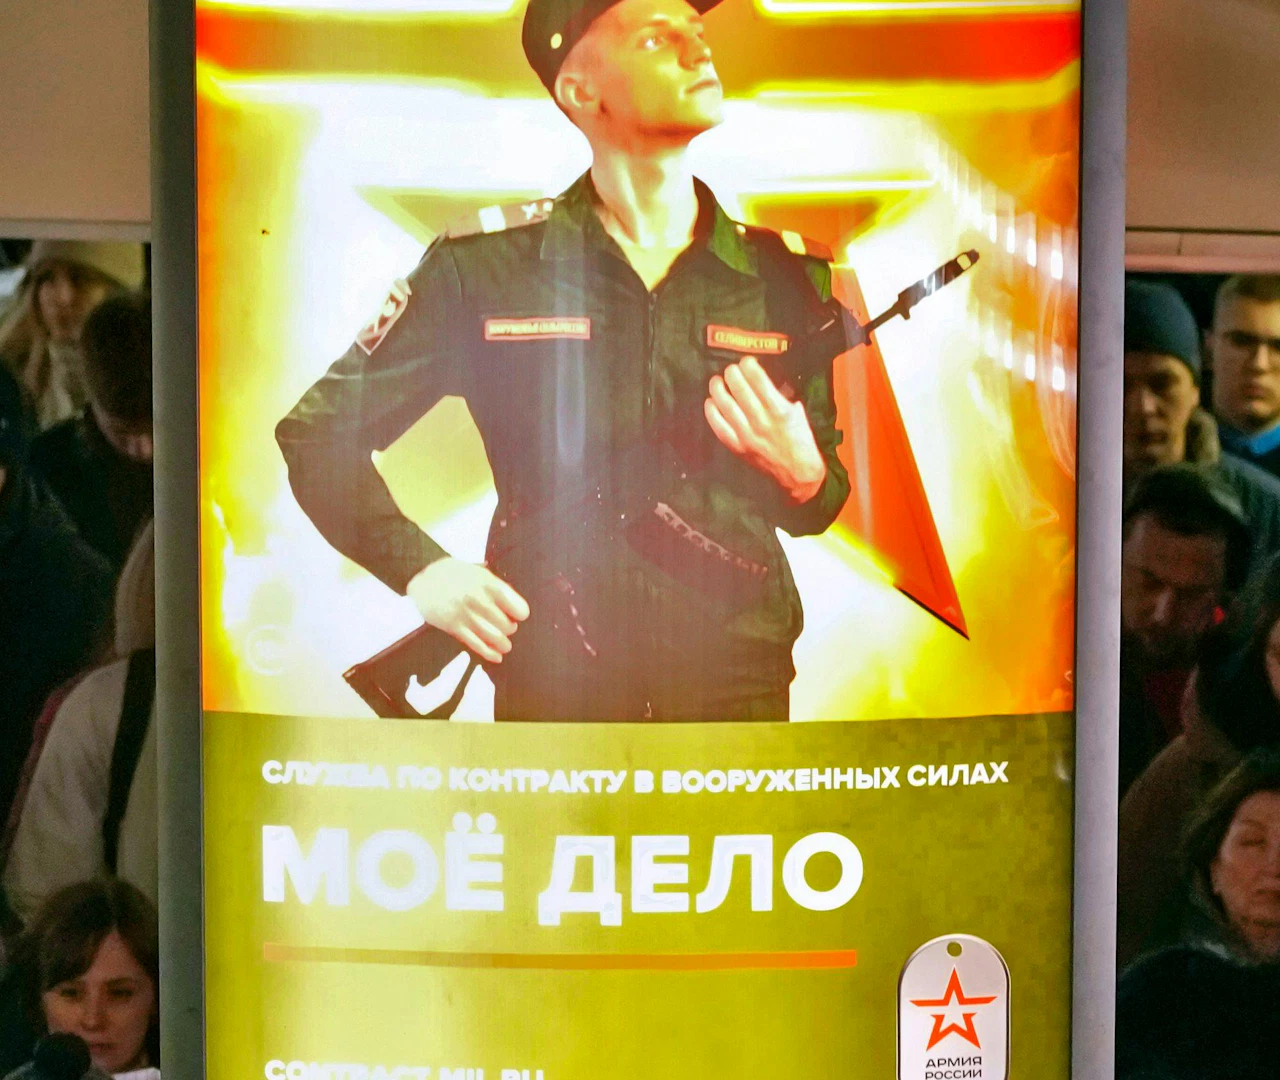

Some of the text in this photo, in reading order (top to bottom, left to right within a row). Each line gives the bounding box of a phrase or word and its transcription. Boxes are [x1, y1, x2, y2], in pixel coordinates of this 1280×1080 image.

[262, 760, 1009, 793] СЛУЖБА ПО КОНТРАКТУ В ВООРУЖЕННЫХ СИЛАХ
[262, 811, 864, 926] МОЁ ДЕЛО
[925, 1056, 982, 1069] АРМИЯ
[925, 1069, 982, 1080] РОССИИ
